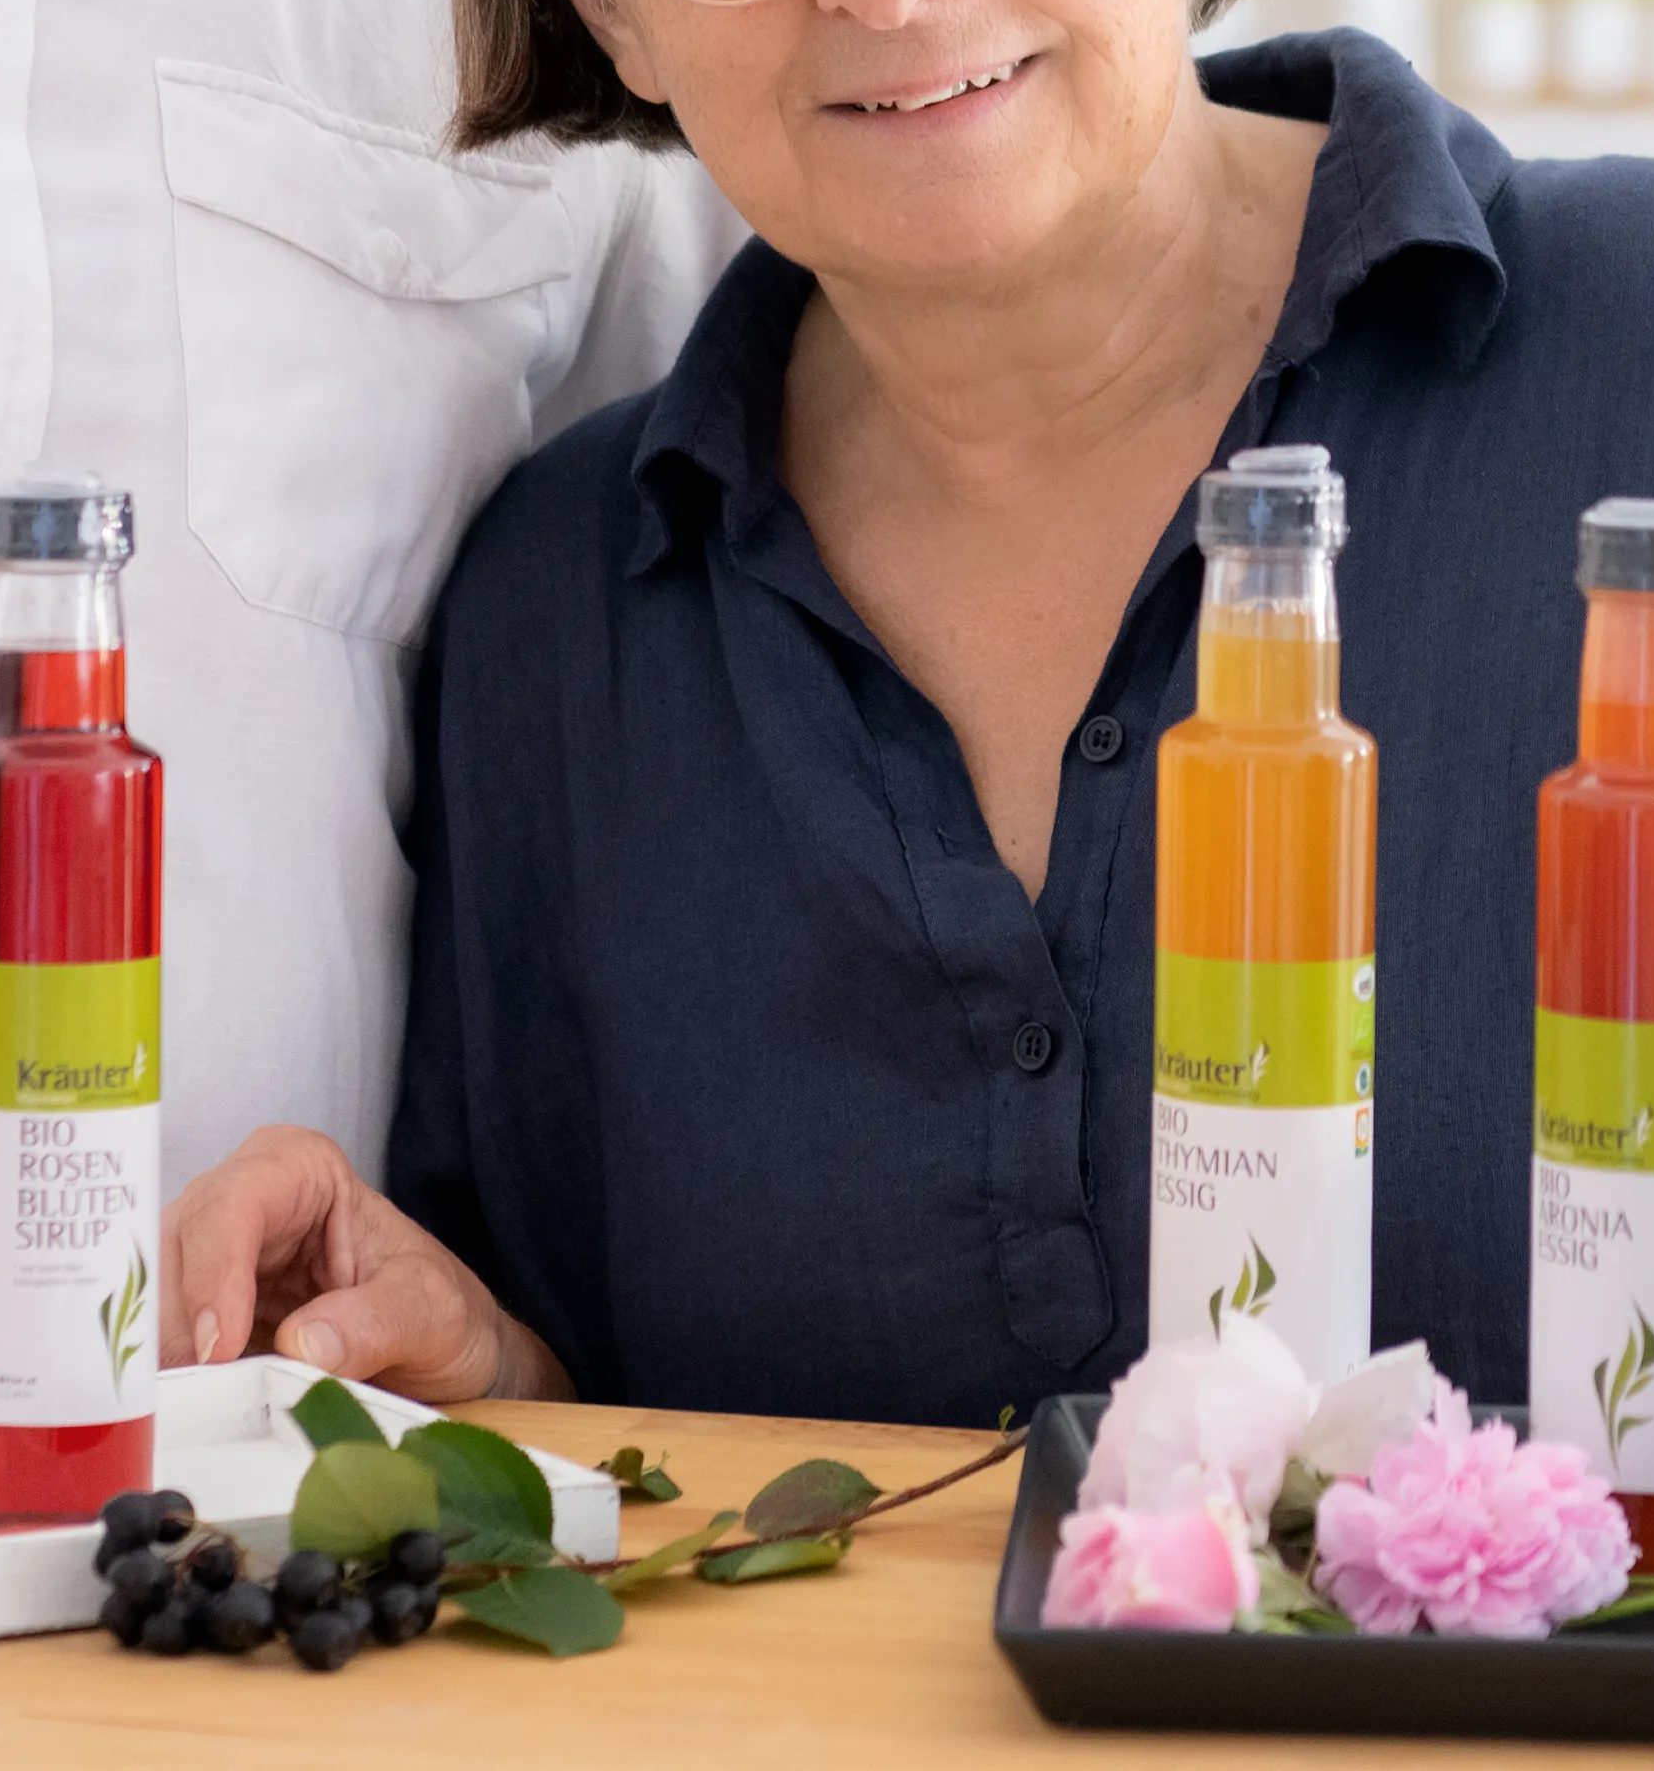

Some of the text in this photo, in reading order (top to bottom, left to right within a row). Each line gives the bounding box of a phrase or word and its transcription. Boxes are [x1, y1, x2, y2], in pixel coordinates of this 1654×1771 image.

[16, 1058, 131, 1091] Kräuter
[19, 1118, 76, 1148] BIO
[1158, 1101, 1189, 1136] BIO
[18, 1150, 124, 1183] ROSEN
[1157, 1136, 1278, 1180] THYMIAN
[16, 1180, 138, 1219] BLÜTEN
[1155, 1172, 1217, 1212] ESSIG
[14, 1219, 112, 1250] SIRUP
